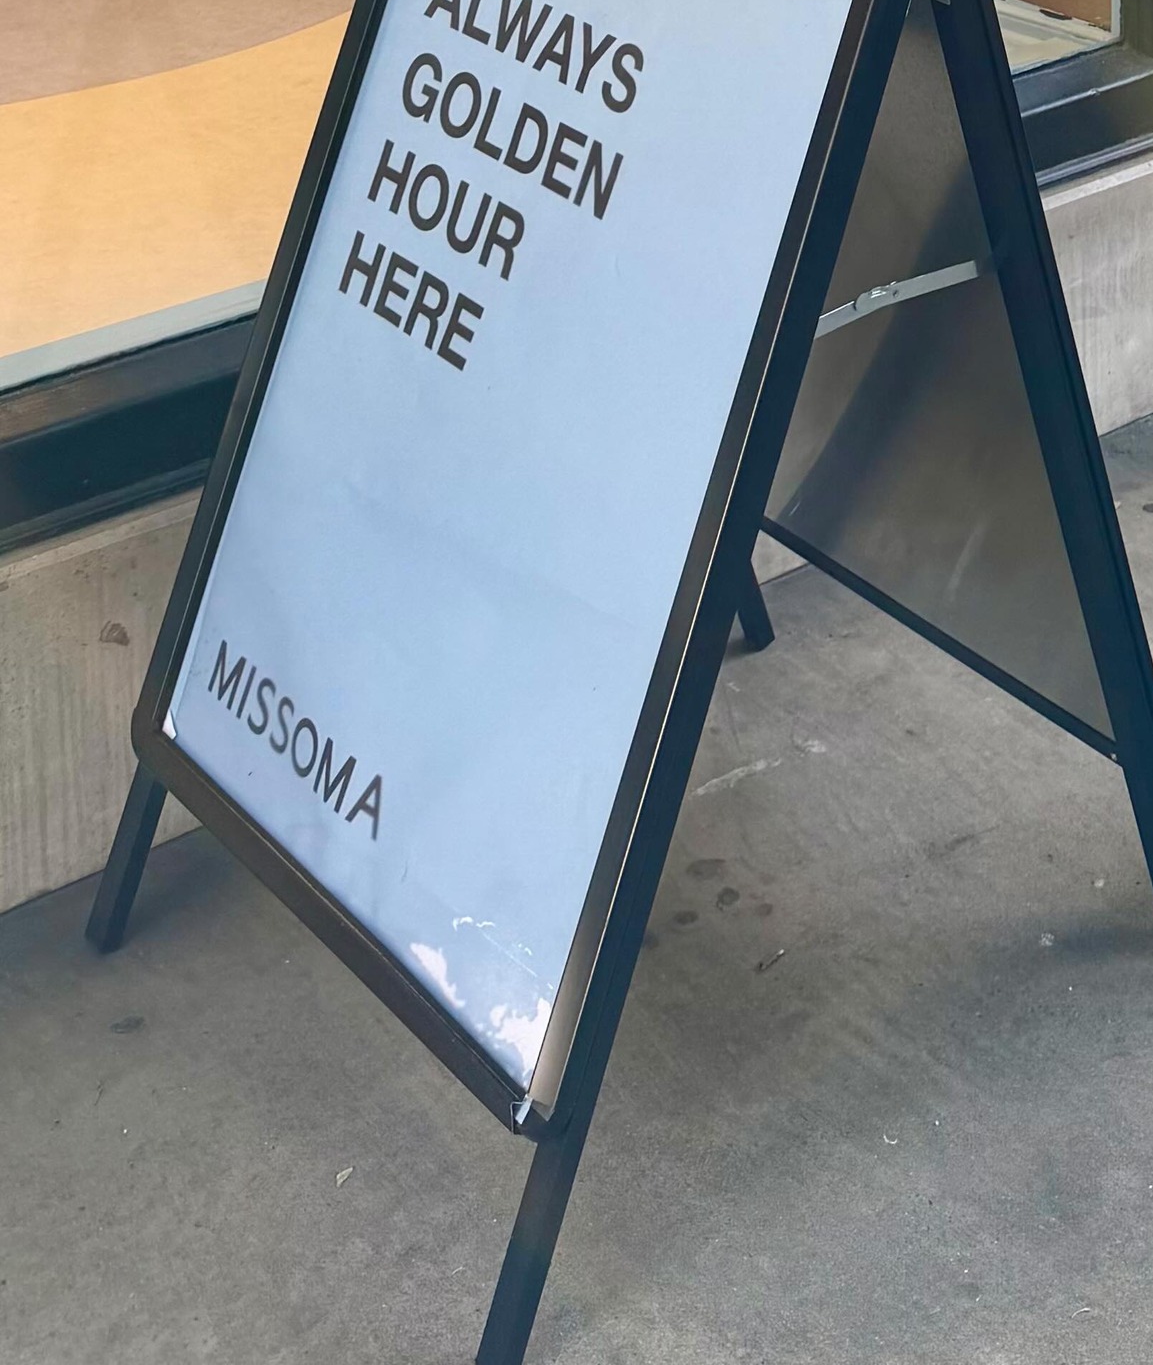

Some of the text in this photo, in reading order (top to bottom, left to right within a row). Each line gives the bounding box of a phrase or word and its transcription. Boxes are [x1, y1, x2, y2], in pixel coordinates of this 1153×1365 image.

[366, 139, 525, 281] HOUR
[402, 52, 624, 220] GOLDEN
[338, 230, 484, 372] HERE
[207, 640, 383, 841] MISSOMA
